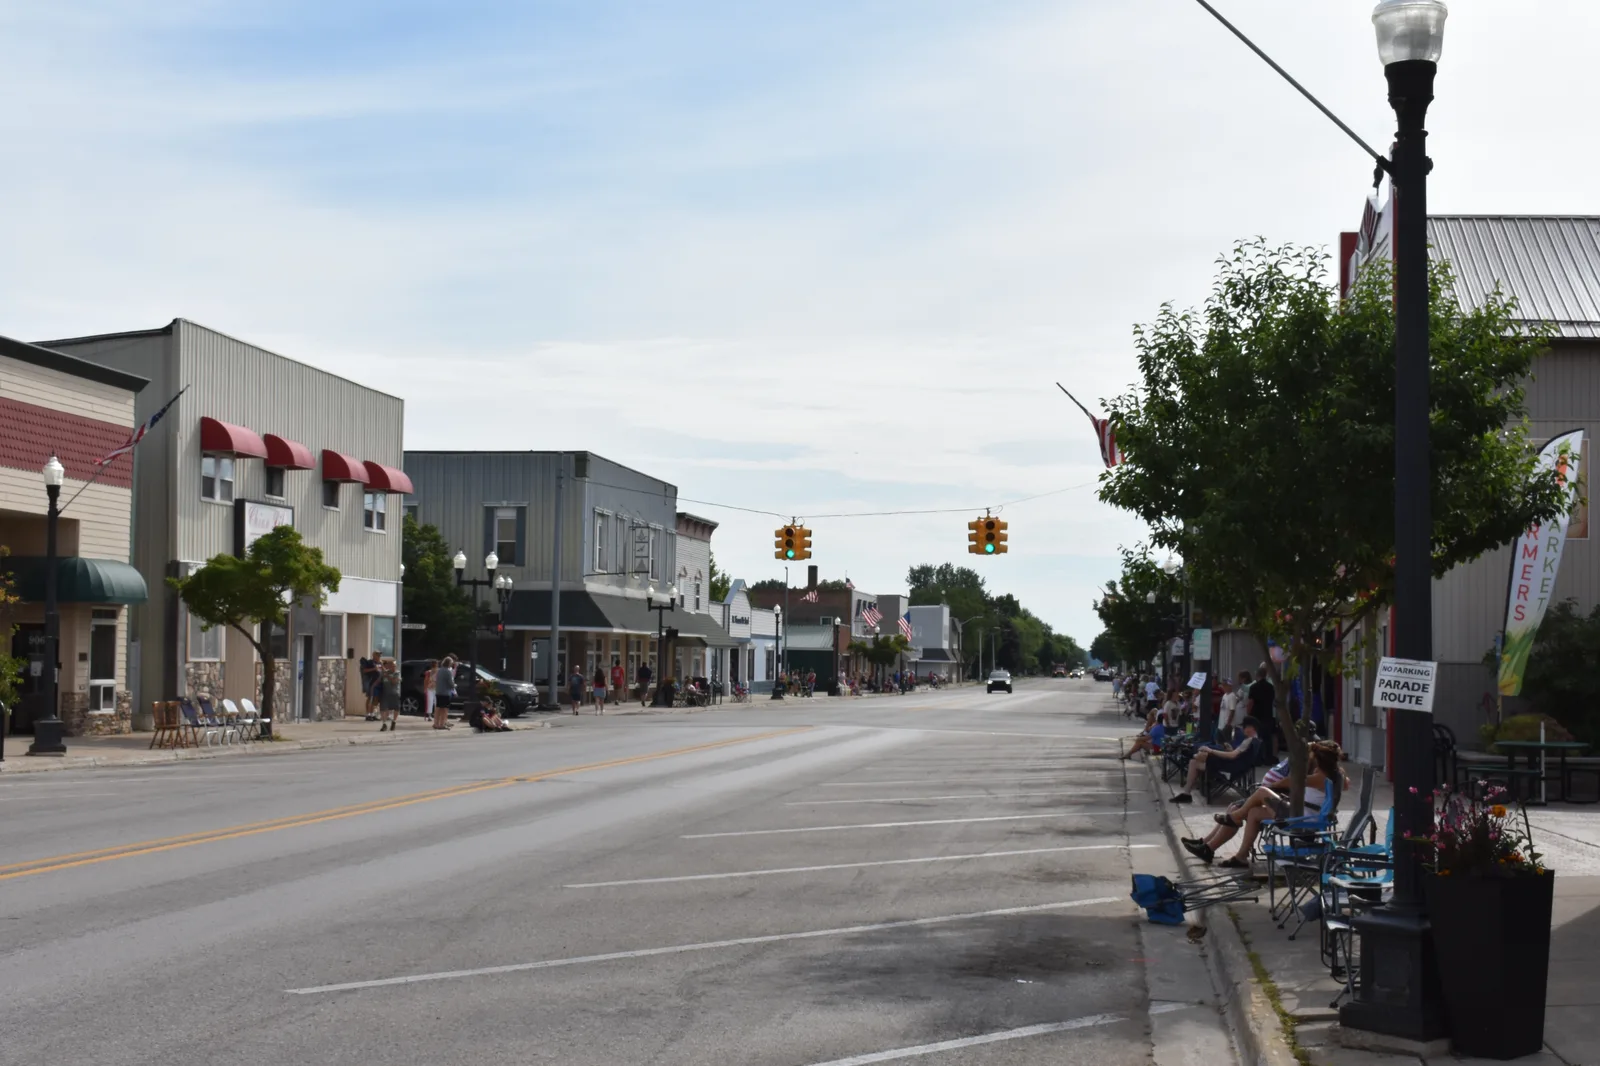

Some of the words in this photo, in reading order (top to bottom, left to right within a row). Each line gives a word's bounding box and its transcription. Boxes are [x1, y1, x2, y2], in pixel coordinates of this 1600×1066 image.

[1513, 522, 1540, 621] RMERS
[1537, 520, 1562, 612] ARKET
[1382, 665, 1393, 673] NO
[1393, 667, 1430, 677] PARKING
[1378, 679, 1430, 693] PARADE
[1380, 691, 1424, 705] ROUTE
